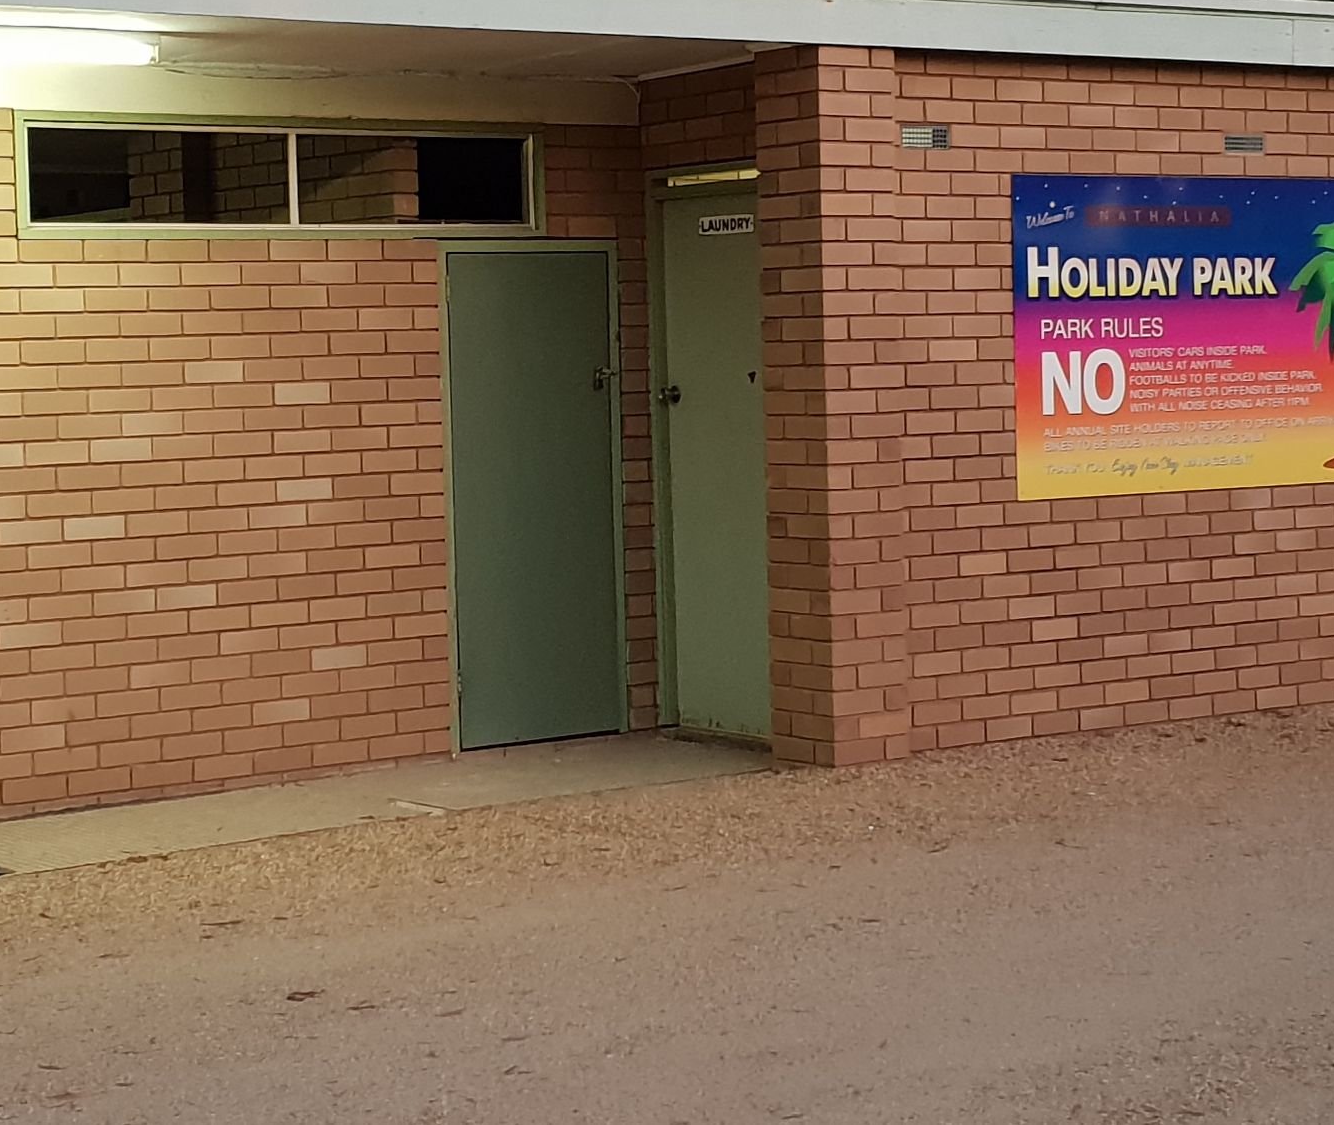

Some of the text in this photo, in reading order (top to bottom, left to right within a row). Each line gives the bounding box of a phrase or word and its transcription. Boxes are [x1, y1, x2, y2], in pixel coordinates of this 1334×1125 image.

[1099, 209, 1220, 223] NATHALIA
[701, 217, 751, 232] LAUNDRY
[1026, 246, 1278, 299] HOLIDAY PARK
[1040, 317, 1164, 340] PARK RULES
[1177, 346, 1205, 357] CARS
[1207, 345, 1238, 356] INSIDE
[1129, 361, 1173, 371] ANIMALS
[1175, 361, 1187, 370] AT
[1041, 348, 1126, 416] NO
[1129, 374, 1187, 386] FOOTBALLS
[1190, 374, 1203, 384] TO
[1205, 373, 1218, 383] BE
[1220, 371, 1256, 382] KICKED
[1257, 371, 1289, 381] INSIDE
[1130, 388, 1160, 399] NOISY
[1162, 386, 1203, 398] PARTIES
[1204, 386, 1218, 397] OR
[1220, 385, 1273, 396] OFFENSIVE
[1130, 402, 1156, 413] WITH
[1158, 402, 1176, 412] ALL
[1178, 400, 1208, 411] NOISE
[1043, 427, 1062, 438] ALL
[1065, 425, 1107, 437] ANNUAL
[1110, 424, 1131, 435] SITE
[1134, 422, 1180, 435] HOLDERS
